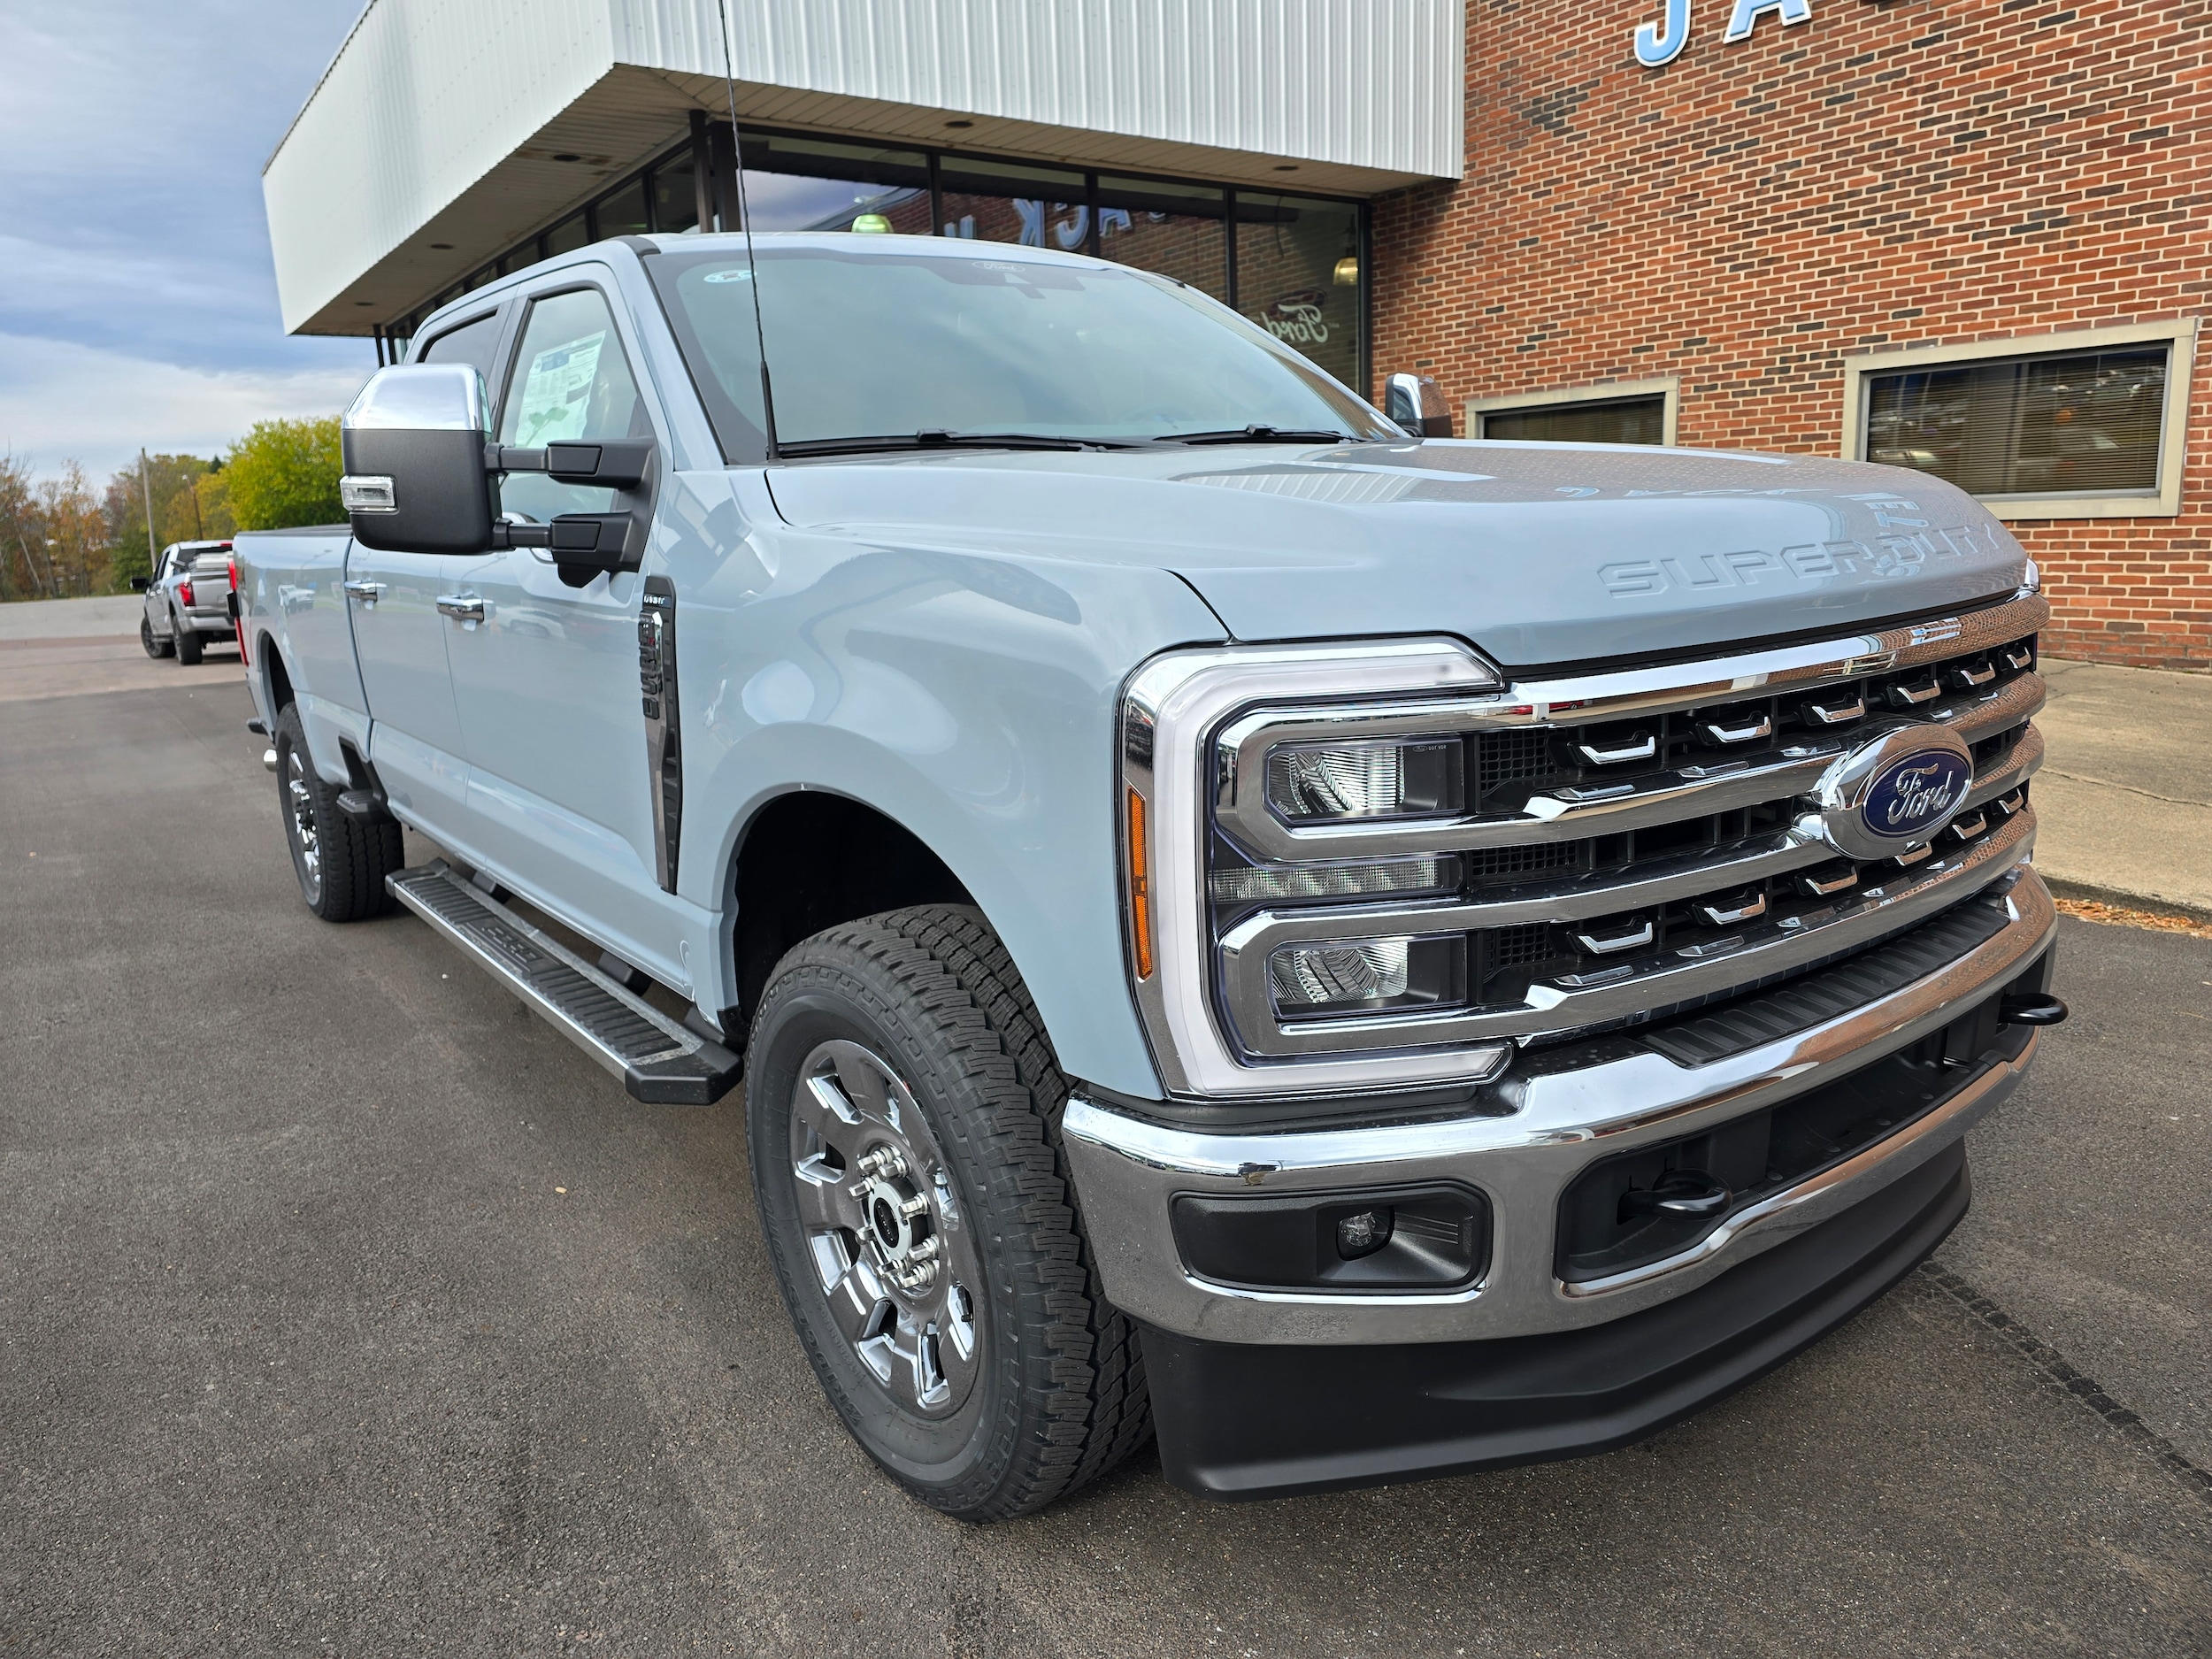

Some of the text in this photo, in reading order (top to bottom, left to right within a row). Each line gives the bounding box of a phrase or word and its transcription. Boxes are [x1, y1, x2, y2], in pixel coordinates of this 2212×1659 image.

[1596, 522, 2001, 599] SUPER DUTY
[1887, 763, 1955, 825] Ford
[760, 1187, 864, 1427] BRIDGESTONE
